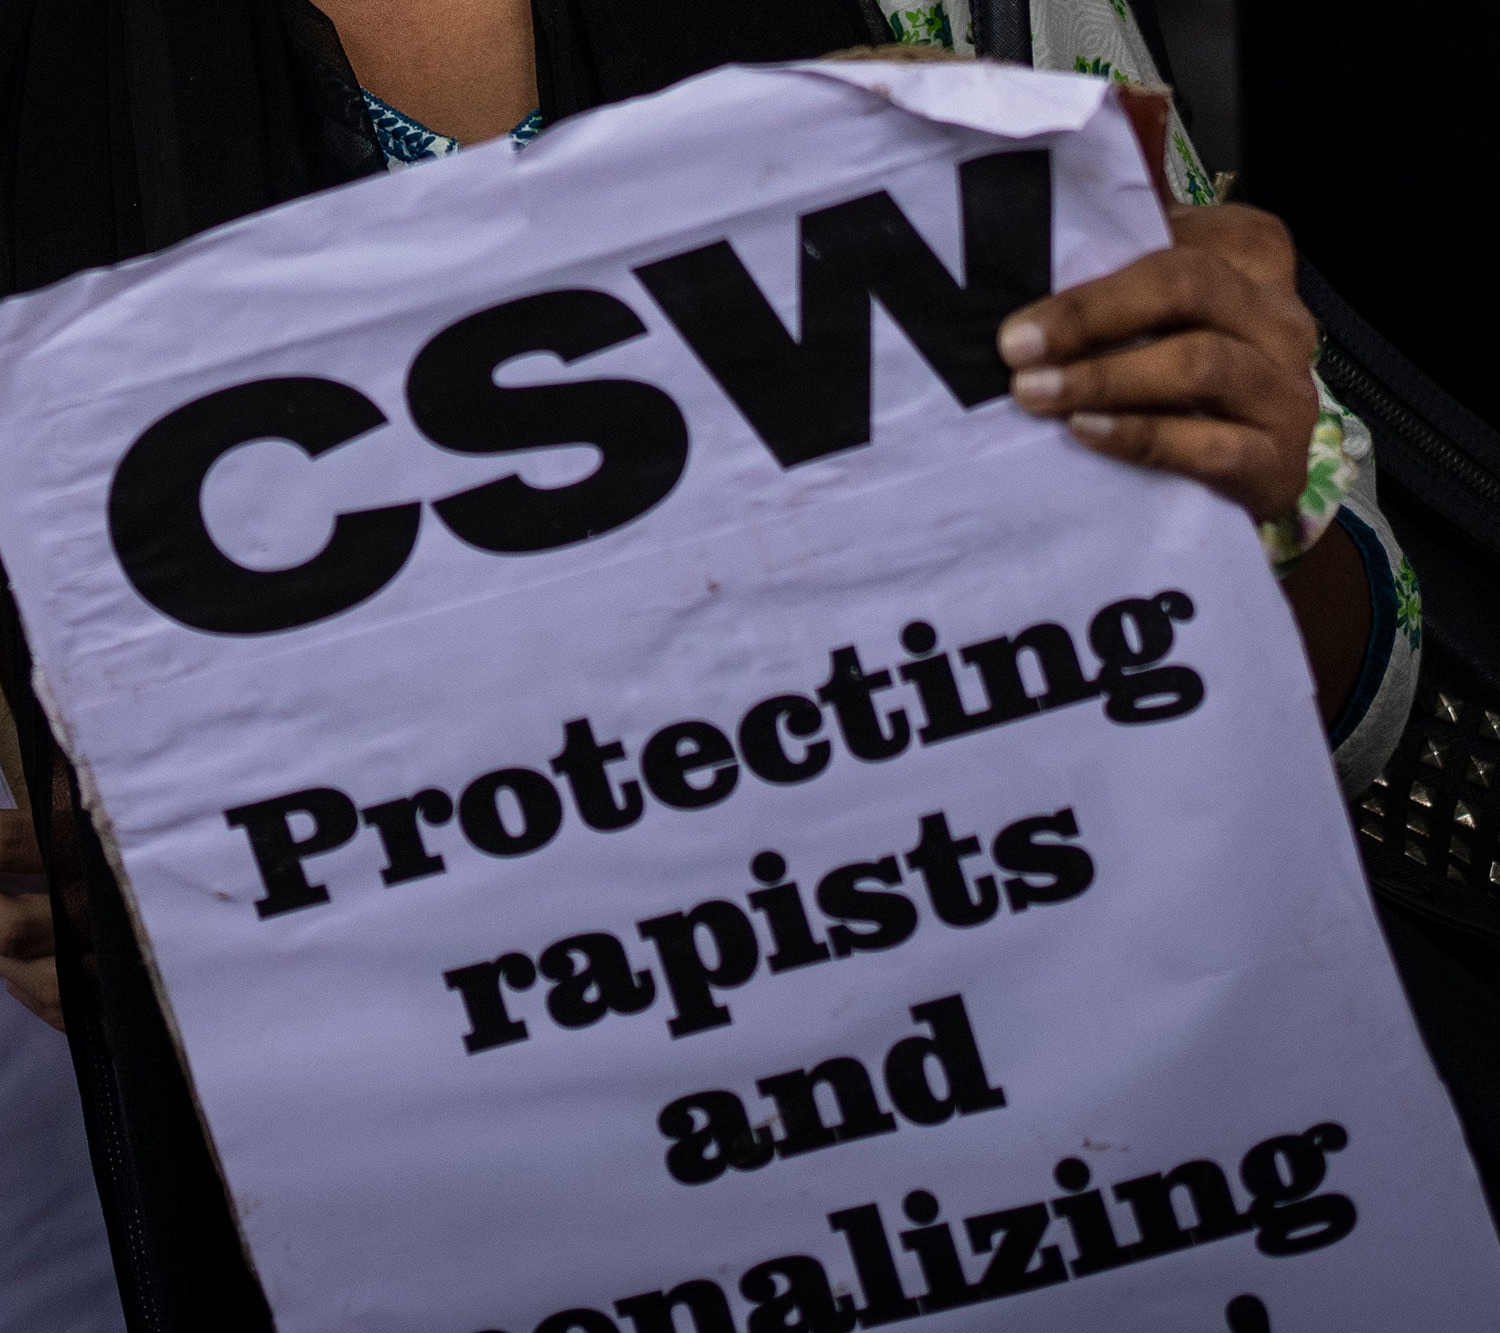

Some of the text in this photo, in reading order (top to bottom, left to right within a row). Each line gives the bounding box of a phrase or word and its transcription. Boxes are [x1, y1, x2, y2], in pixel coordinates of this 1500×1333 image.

[107, 149, 1052, 637] CSW
[223, 590, 1205, 928] Protecting
[443, 808, 1095, 1054] rapists
[658, 994, 1006, 1185] and
